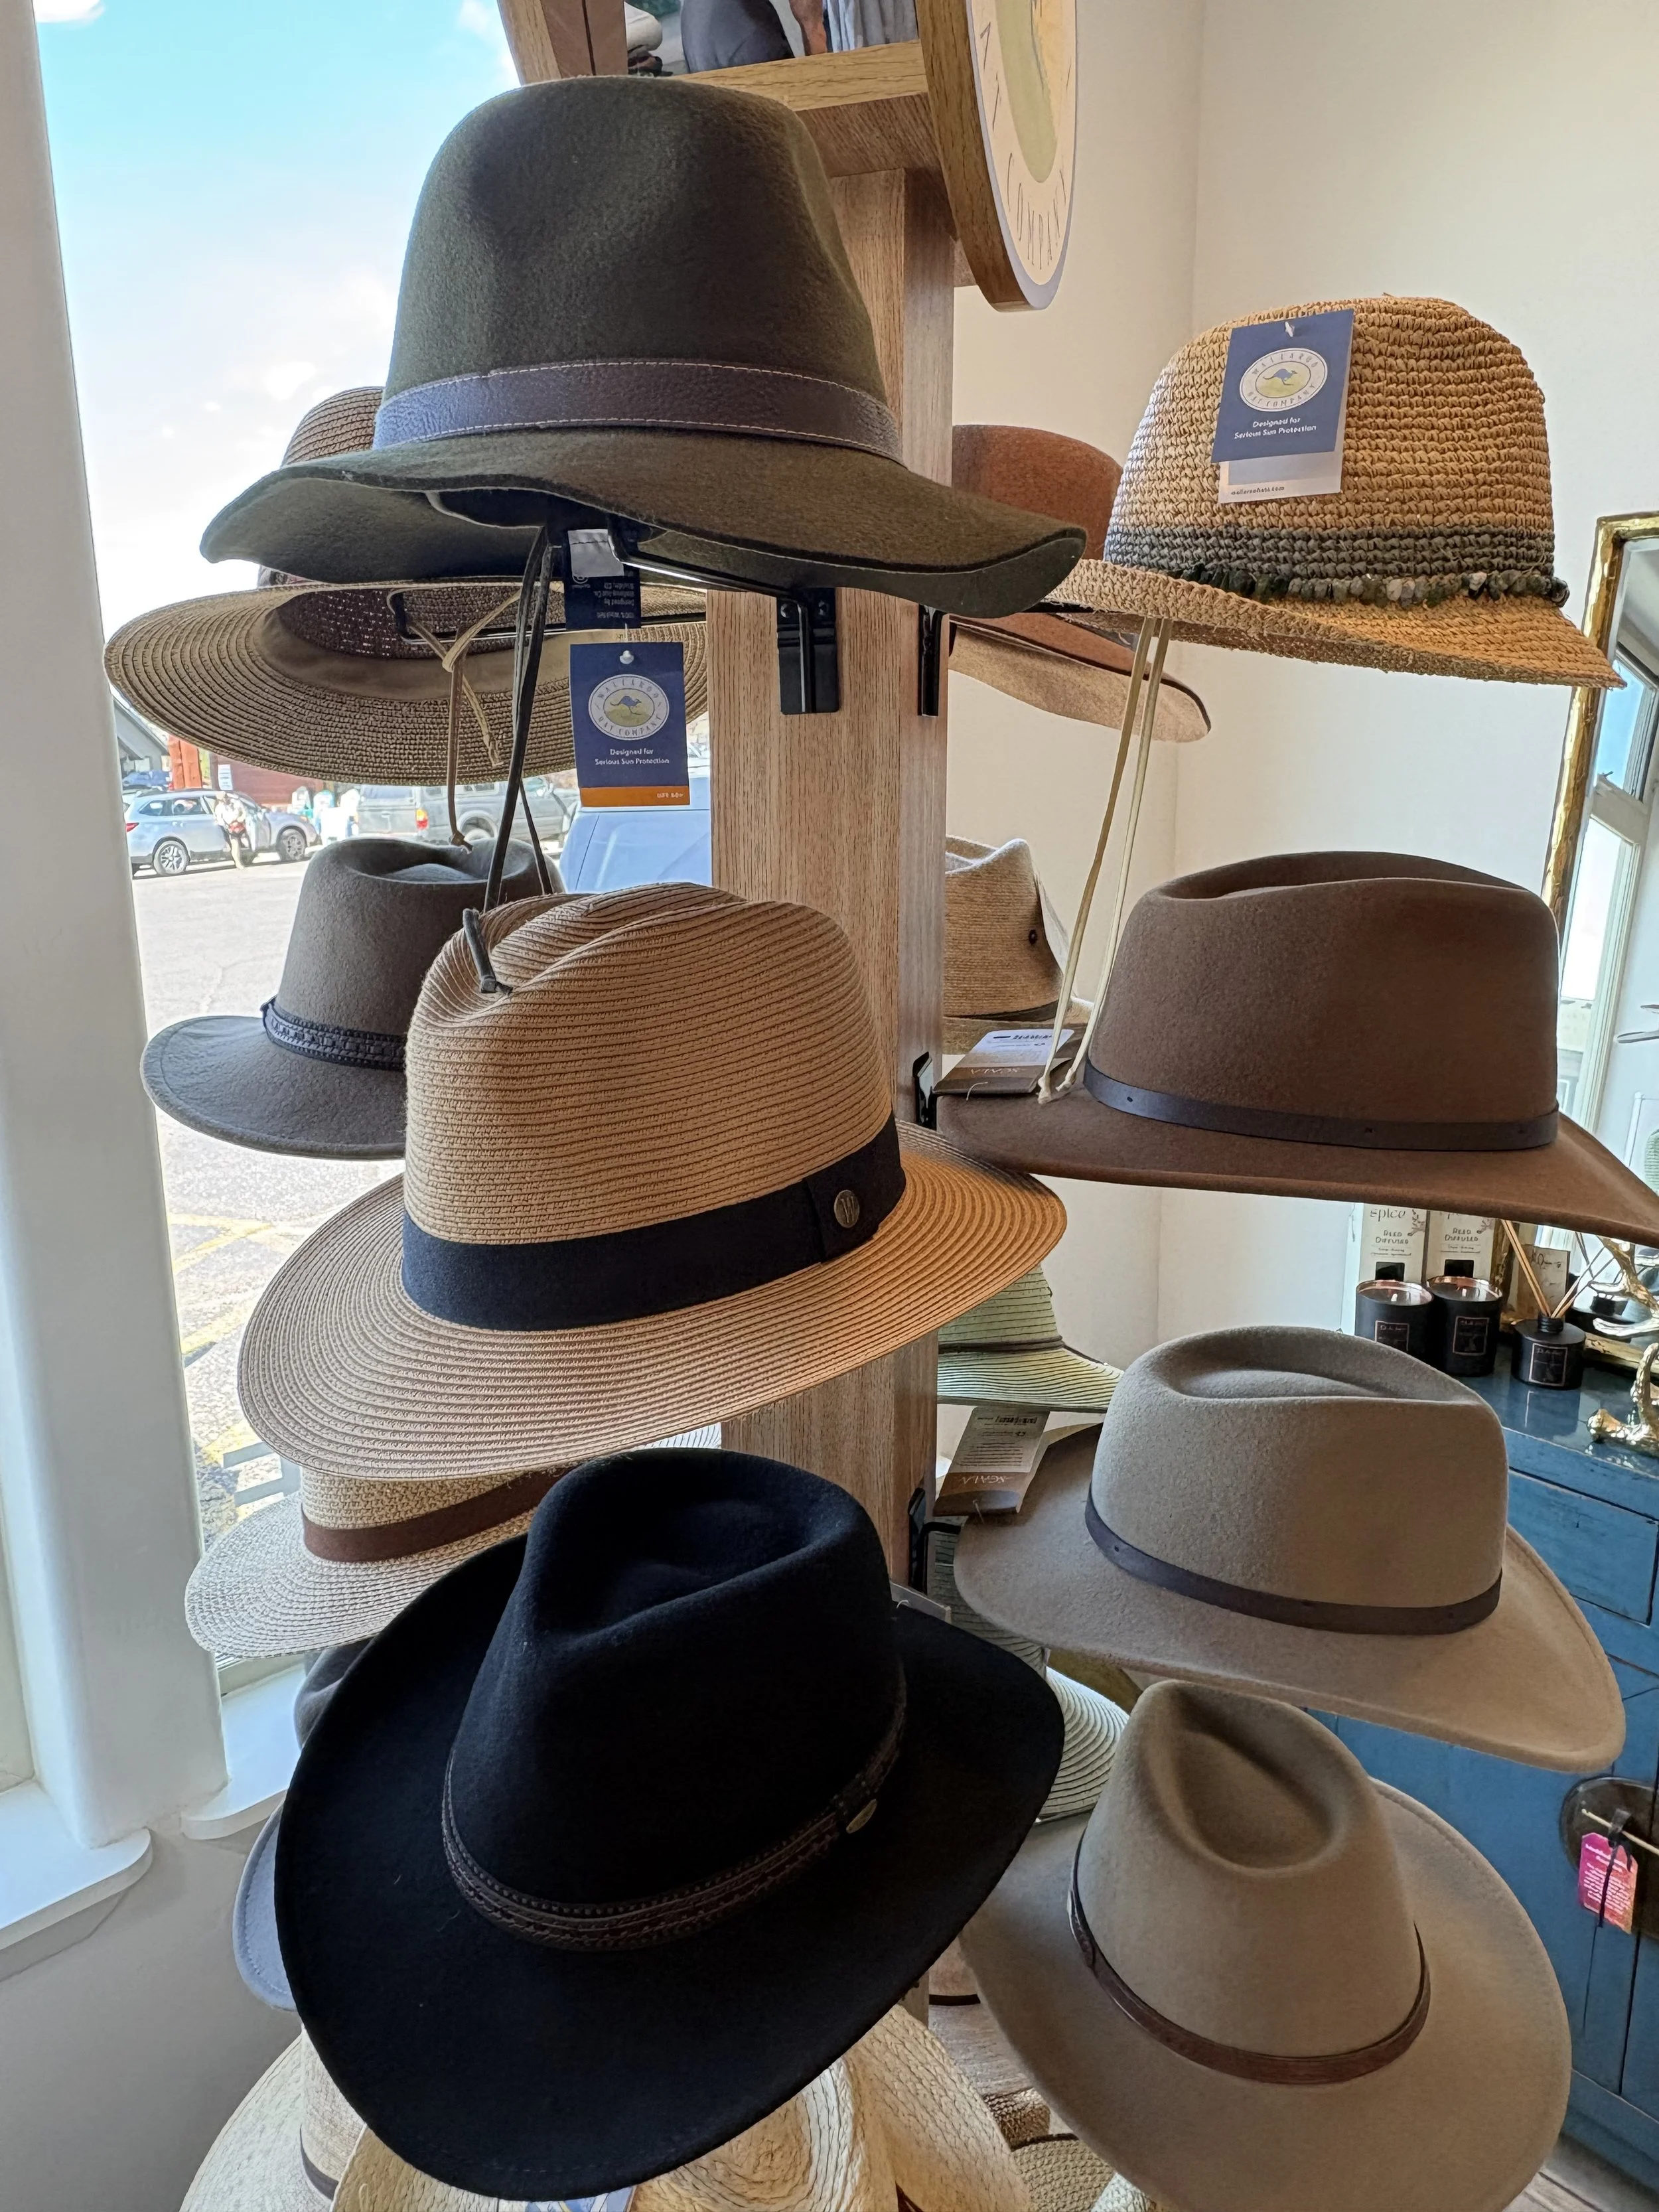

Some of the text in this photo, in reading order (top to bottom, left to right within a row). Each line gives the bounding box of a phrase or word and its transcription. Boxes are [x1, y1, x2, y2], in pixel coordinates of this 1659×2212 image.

[1265, 384, 1315, 407] COMPANY
[1252, 417, 1288, 428] Designed
[1234, 431, 1262, 439] Serious
[1278, 425, 1317, 435] Protection
[618, 715, 662, 736] COMPANY
